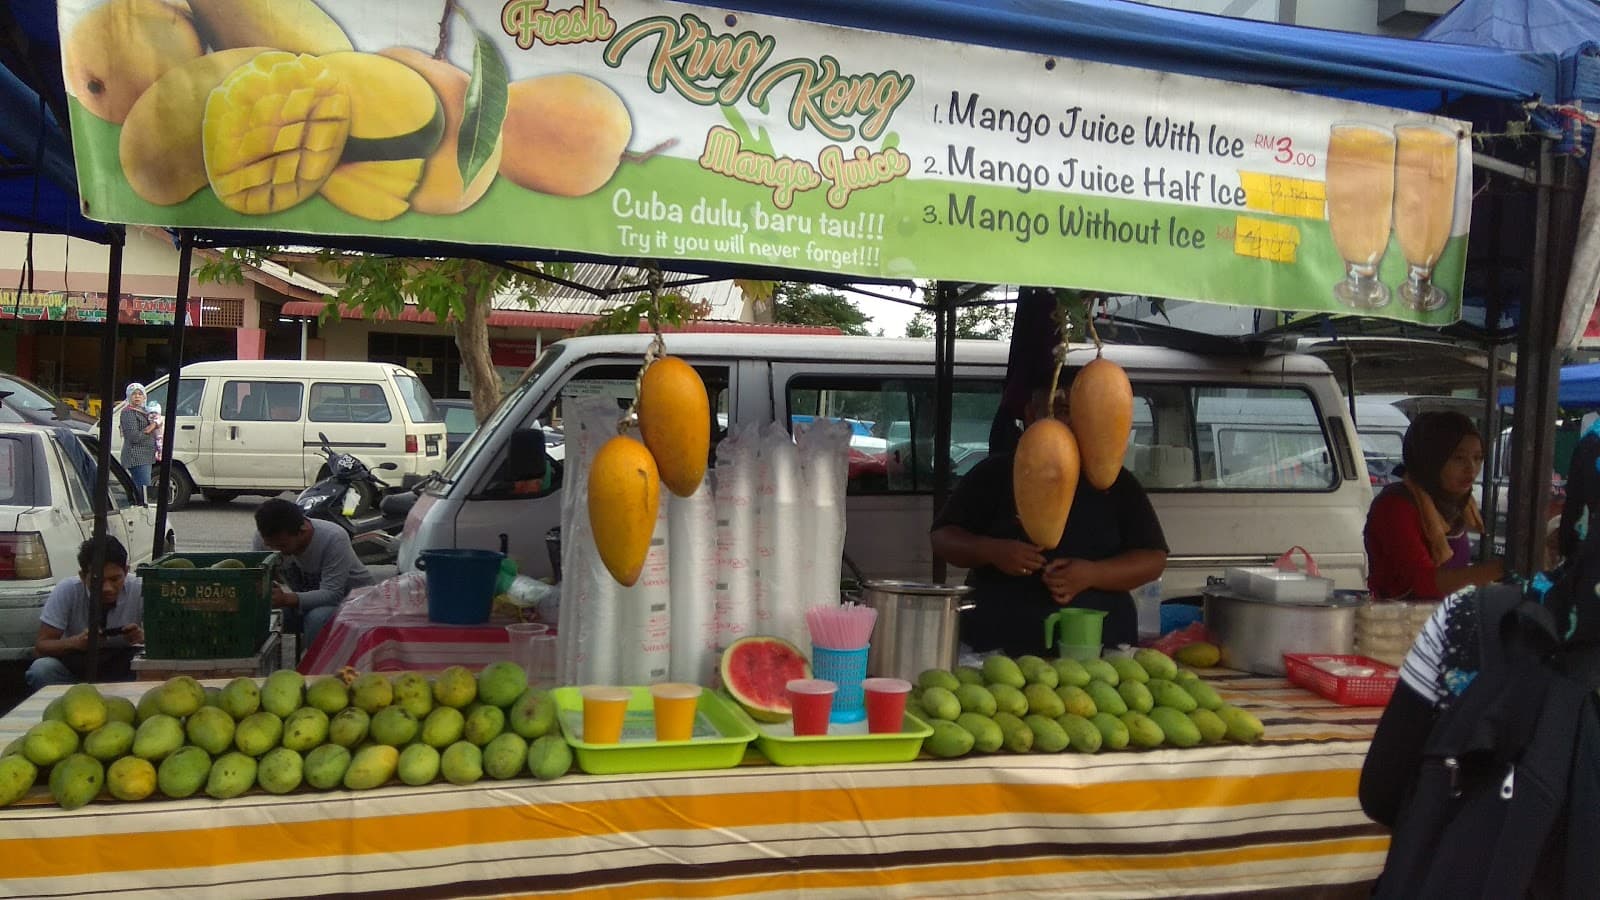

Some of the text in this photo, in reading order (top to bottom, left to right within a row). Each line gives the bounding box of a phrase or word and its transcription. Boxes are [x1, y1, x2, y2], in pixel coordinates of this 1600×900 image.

[502, 0, 617, 49] Fresh
[604, 14, 914, 141] King Kong
[948, 90, 1051, 144] Mango
[1058, 106, 1135, 145] Juice
[1145, 115, 1200, 154] With
[1208, 124, 1244, 158] Ice
[699, 125, 910, 210] Mango Juice
[924, 156, 943, 175] 2.
[948, 144, 1050, 193] Mango
[1058, 158, 1135, 194] Juice
[1144, 167, 1205, 202] Half
[1210, 174, 1247, 206] Ice
[612, 188, 885, 241] Cuba dulu, baru tau!!!
[922, 205, 943, 225] 3.
[948, 192, 1049, 243] Mango
[1059, 204, 1160, 245] Without
[1169, 216, 1206, 249] Ice
[617, 225, 881, 269] Try it you will never forget!!!
